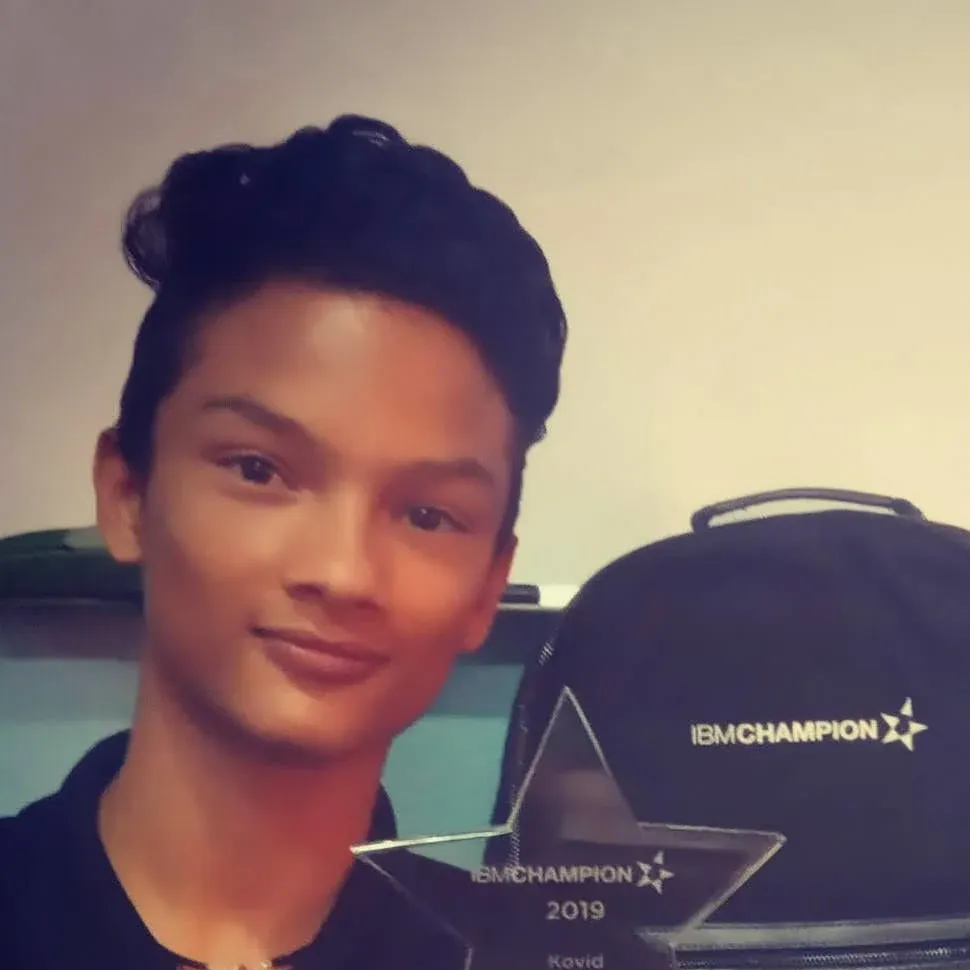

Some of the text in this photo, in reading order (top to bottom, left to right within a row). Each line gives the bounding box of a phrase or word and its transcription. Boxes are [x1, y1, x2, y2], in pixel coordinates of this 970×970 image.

[691, 719, 879, 746] IBMCHAMPION
[470, 866, 633, 884] IBMCHAMPION
[545, 901, 606, 921] 2019
[547, 953, 605, 970] Kovid
